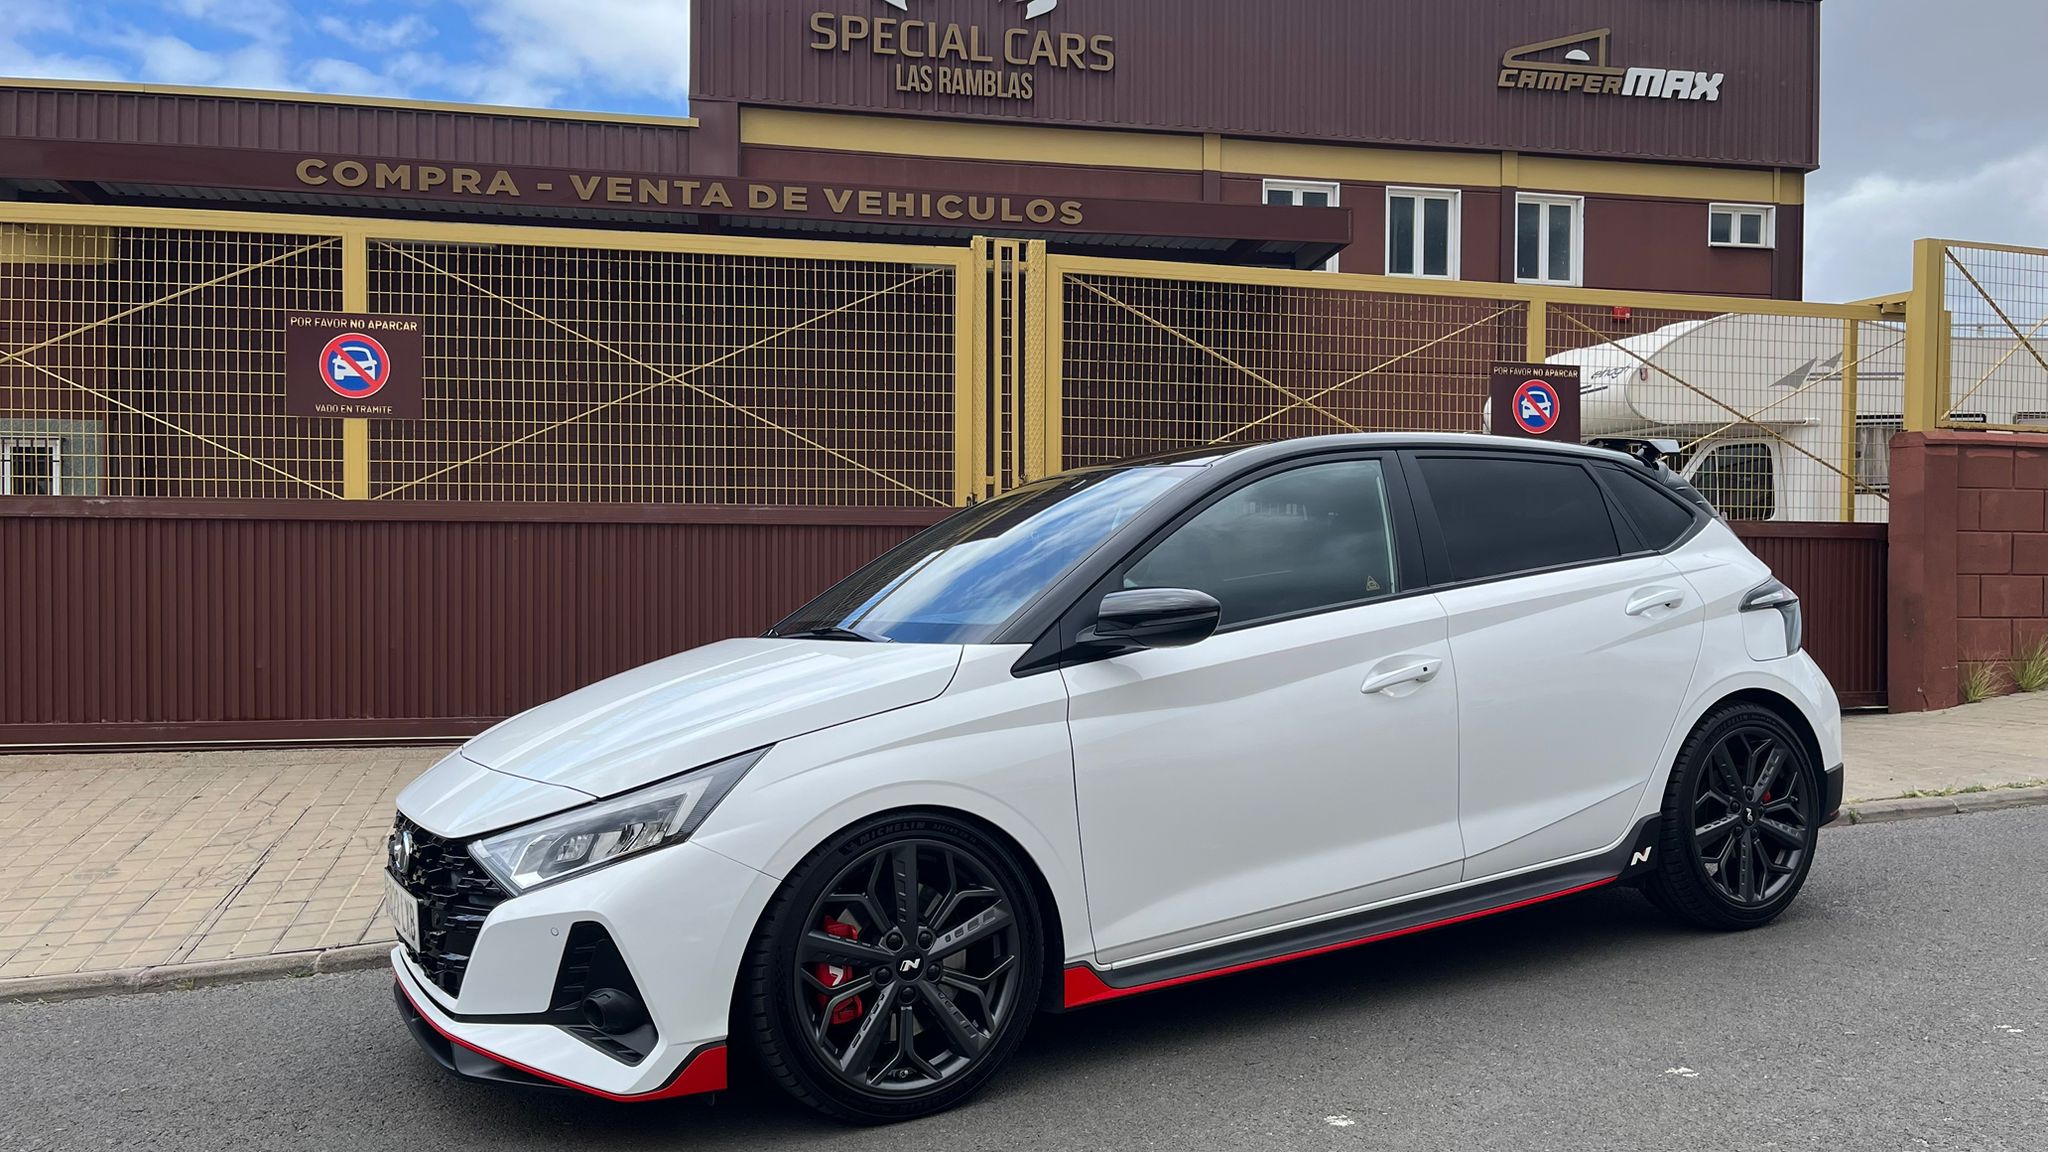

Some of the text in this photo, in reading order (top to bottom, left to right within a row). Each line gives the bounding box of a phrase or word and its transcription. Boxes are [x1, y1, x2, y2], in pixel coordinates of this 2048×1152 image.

[810, 11, 1115, 72] SPECIAL CARS
[895, 64, 1033, 100] LAS RAMBLAS
[295, 158, 521, 197] COMPRA
[569, 174, 733, 208] VENTA
[748, 183, 808, 212] DE
[823, 188, 1083, 225] VEHICULOS
[290, 316, 418, 331] POR FAVOR NO APARCAR
[1493, 366, 1578, 378] POR FAVOR NO APARCAR
[315, 403, 393, 414] VADO EN TRAMITE
[859, 821, 926, 845] MICHELIN
